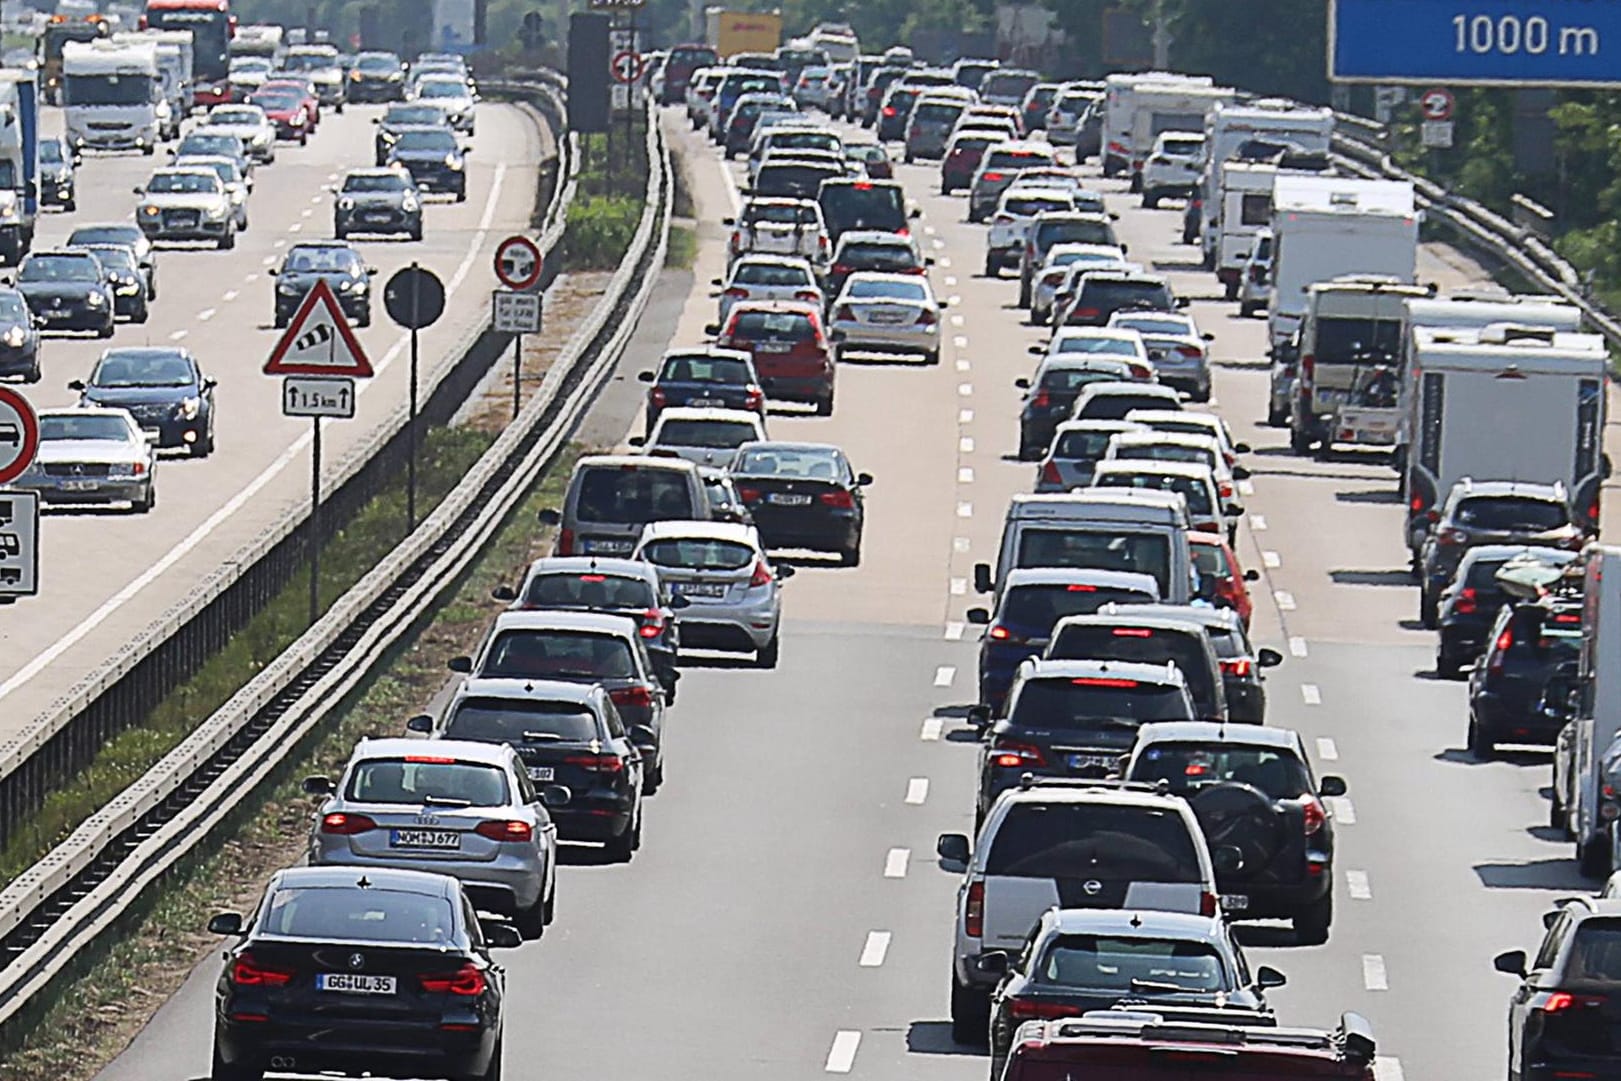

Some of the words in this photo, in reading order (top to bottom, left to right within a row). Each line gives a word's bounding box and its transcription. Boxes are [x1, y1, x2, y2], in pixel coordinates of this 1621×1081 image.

[1452, 14, 1548, 54] 1000
[1559, 27, 1598, 55] m
[321, 395, 337, 408] km
[436, 833, 459, 845] 677
[373, 977, 392, 992] 35
